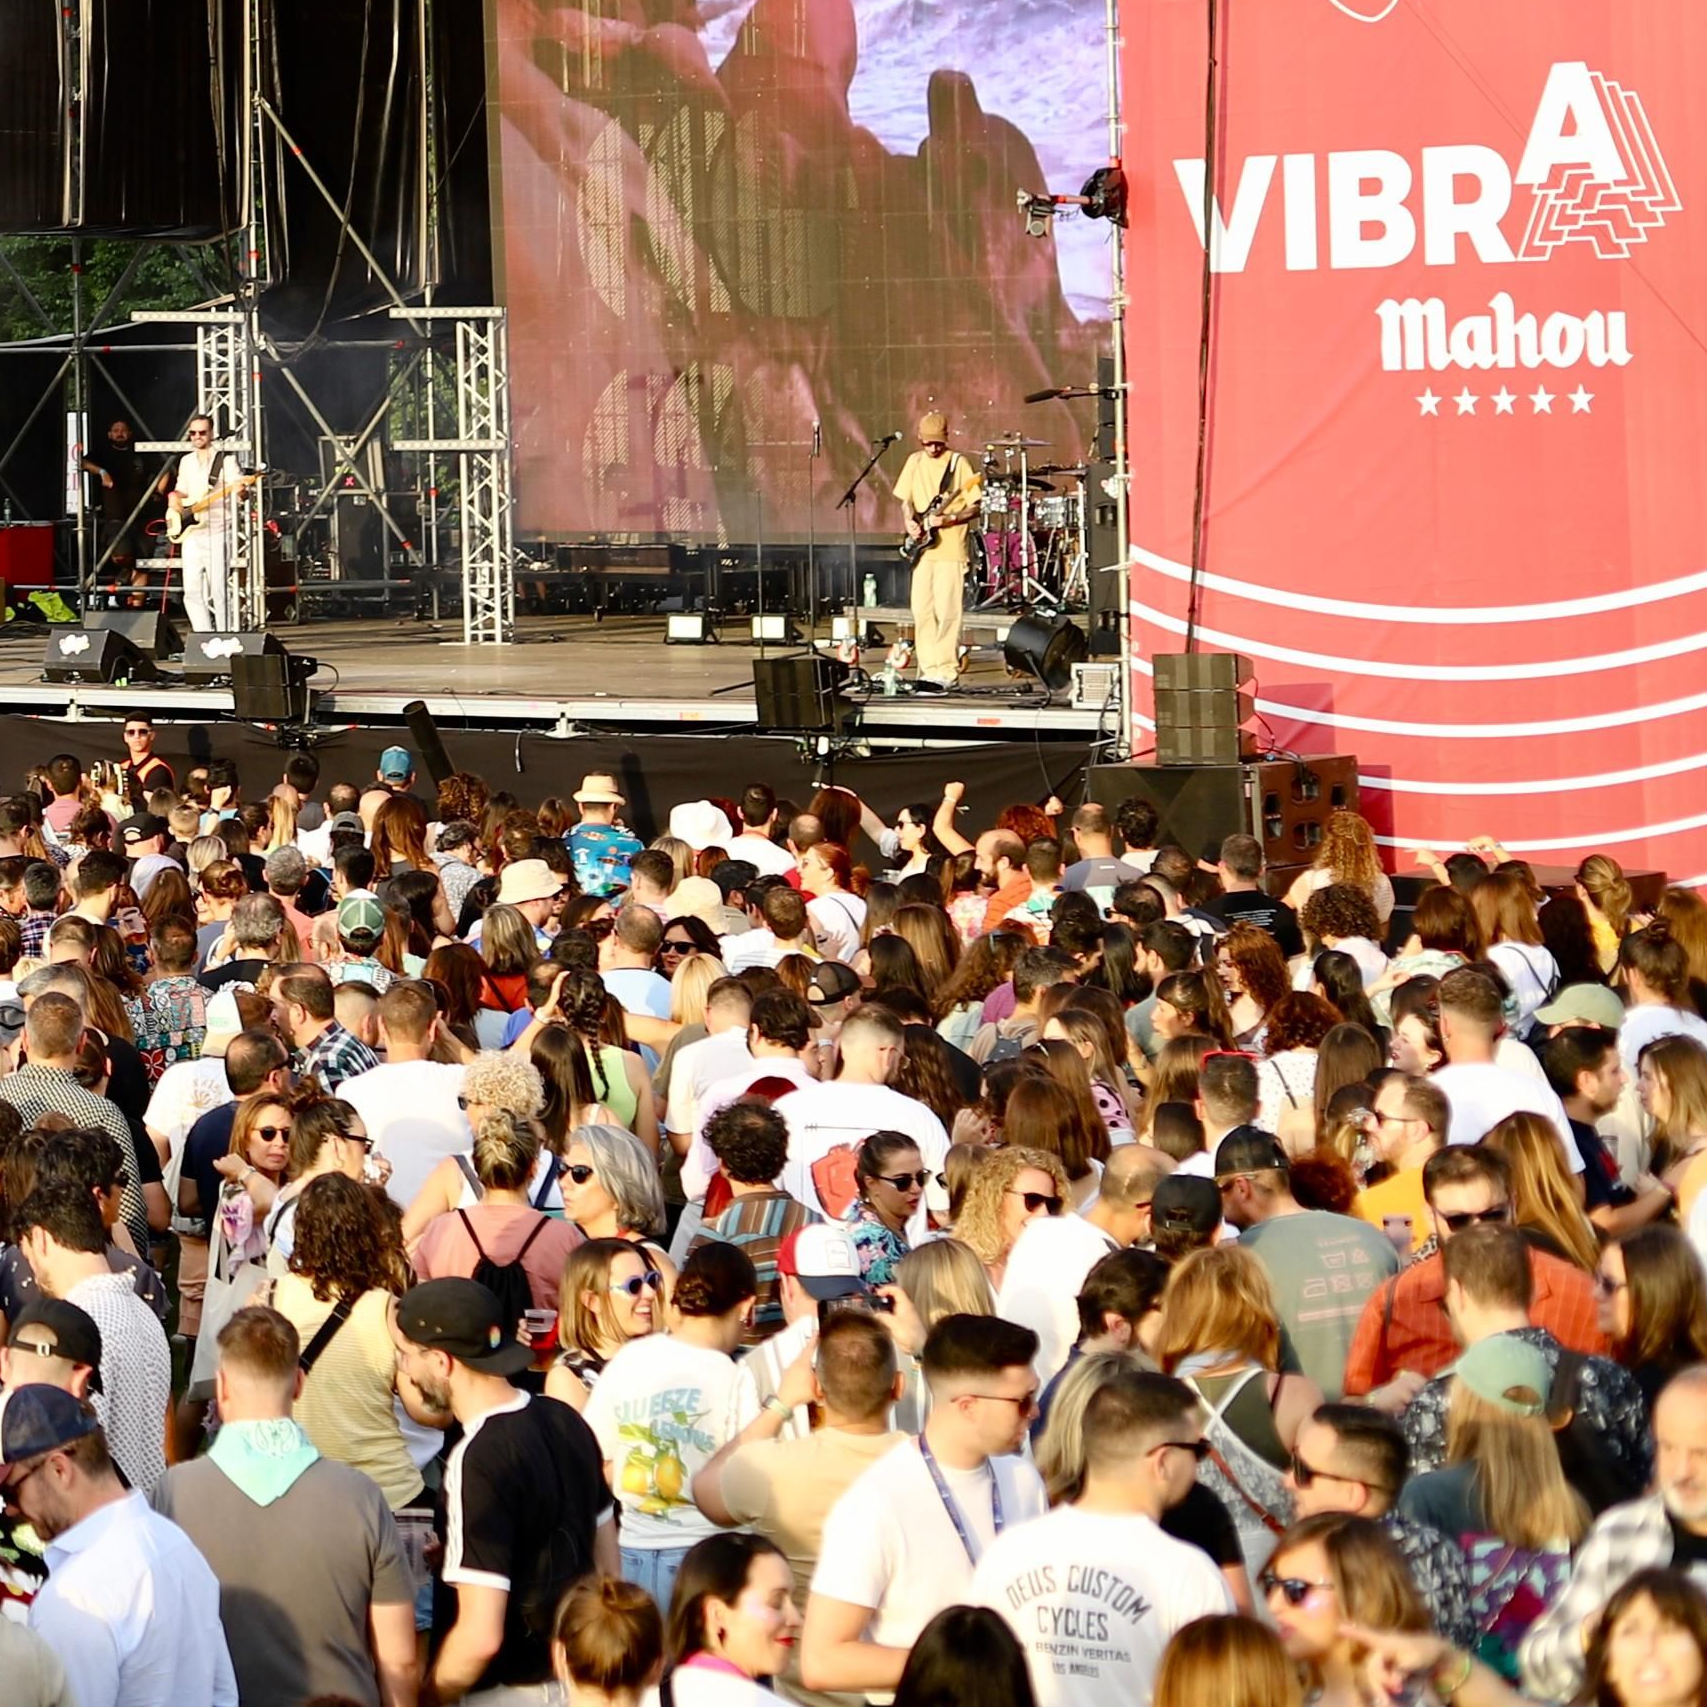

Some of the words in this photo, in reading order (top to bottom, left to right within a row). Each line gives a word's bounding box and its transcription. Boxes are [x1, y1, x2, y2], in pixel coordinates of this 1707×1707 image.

[1173, 62, 1684, 274] VIBRA
[1375, 291, 1634, 371] Mahou
[1005, 1564, 1057, 1611] DEUS
[1067, 1564, 1153, 1626] CUSTOM
[1036, 1605, 1110, 1642] CYCLES
[1035, 1641, 1079, 1657] BENZIN
[1081, 1648, 1132, 1663] VERITAS
